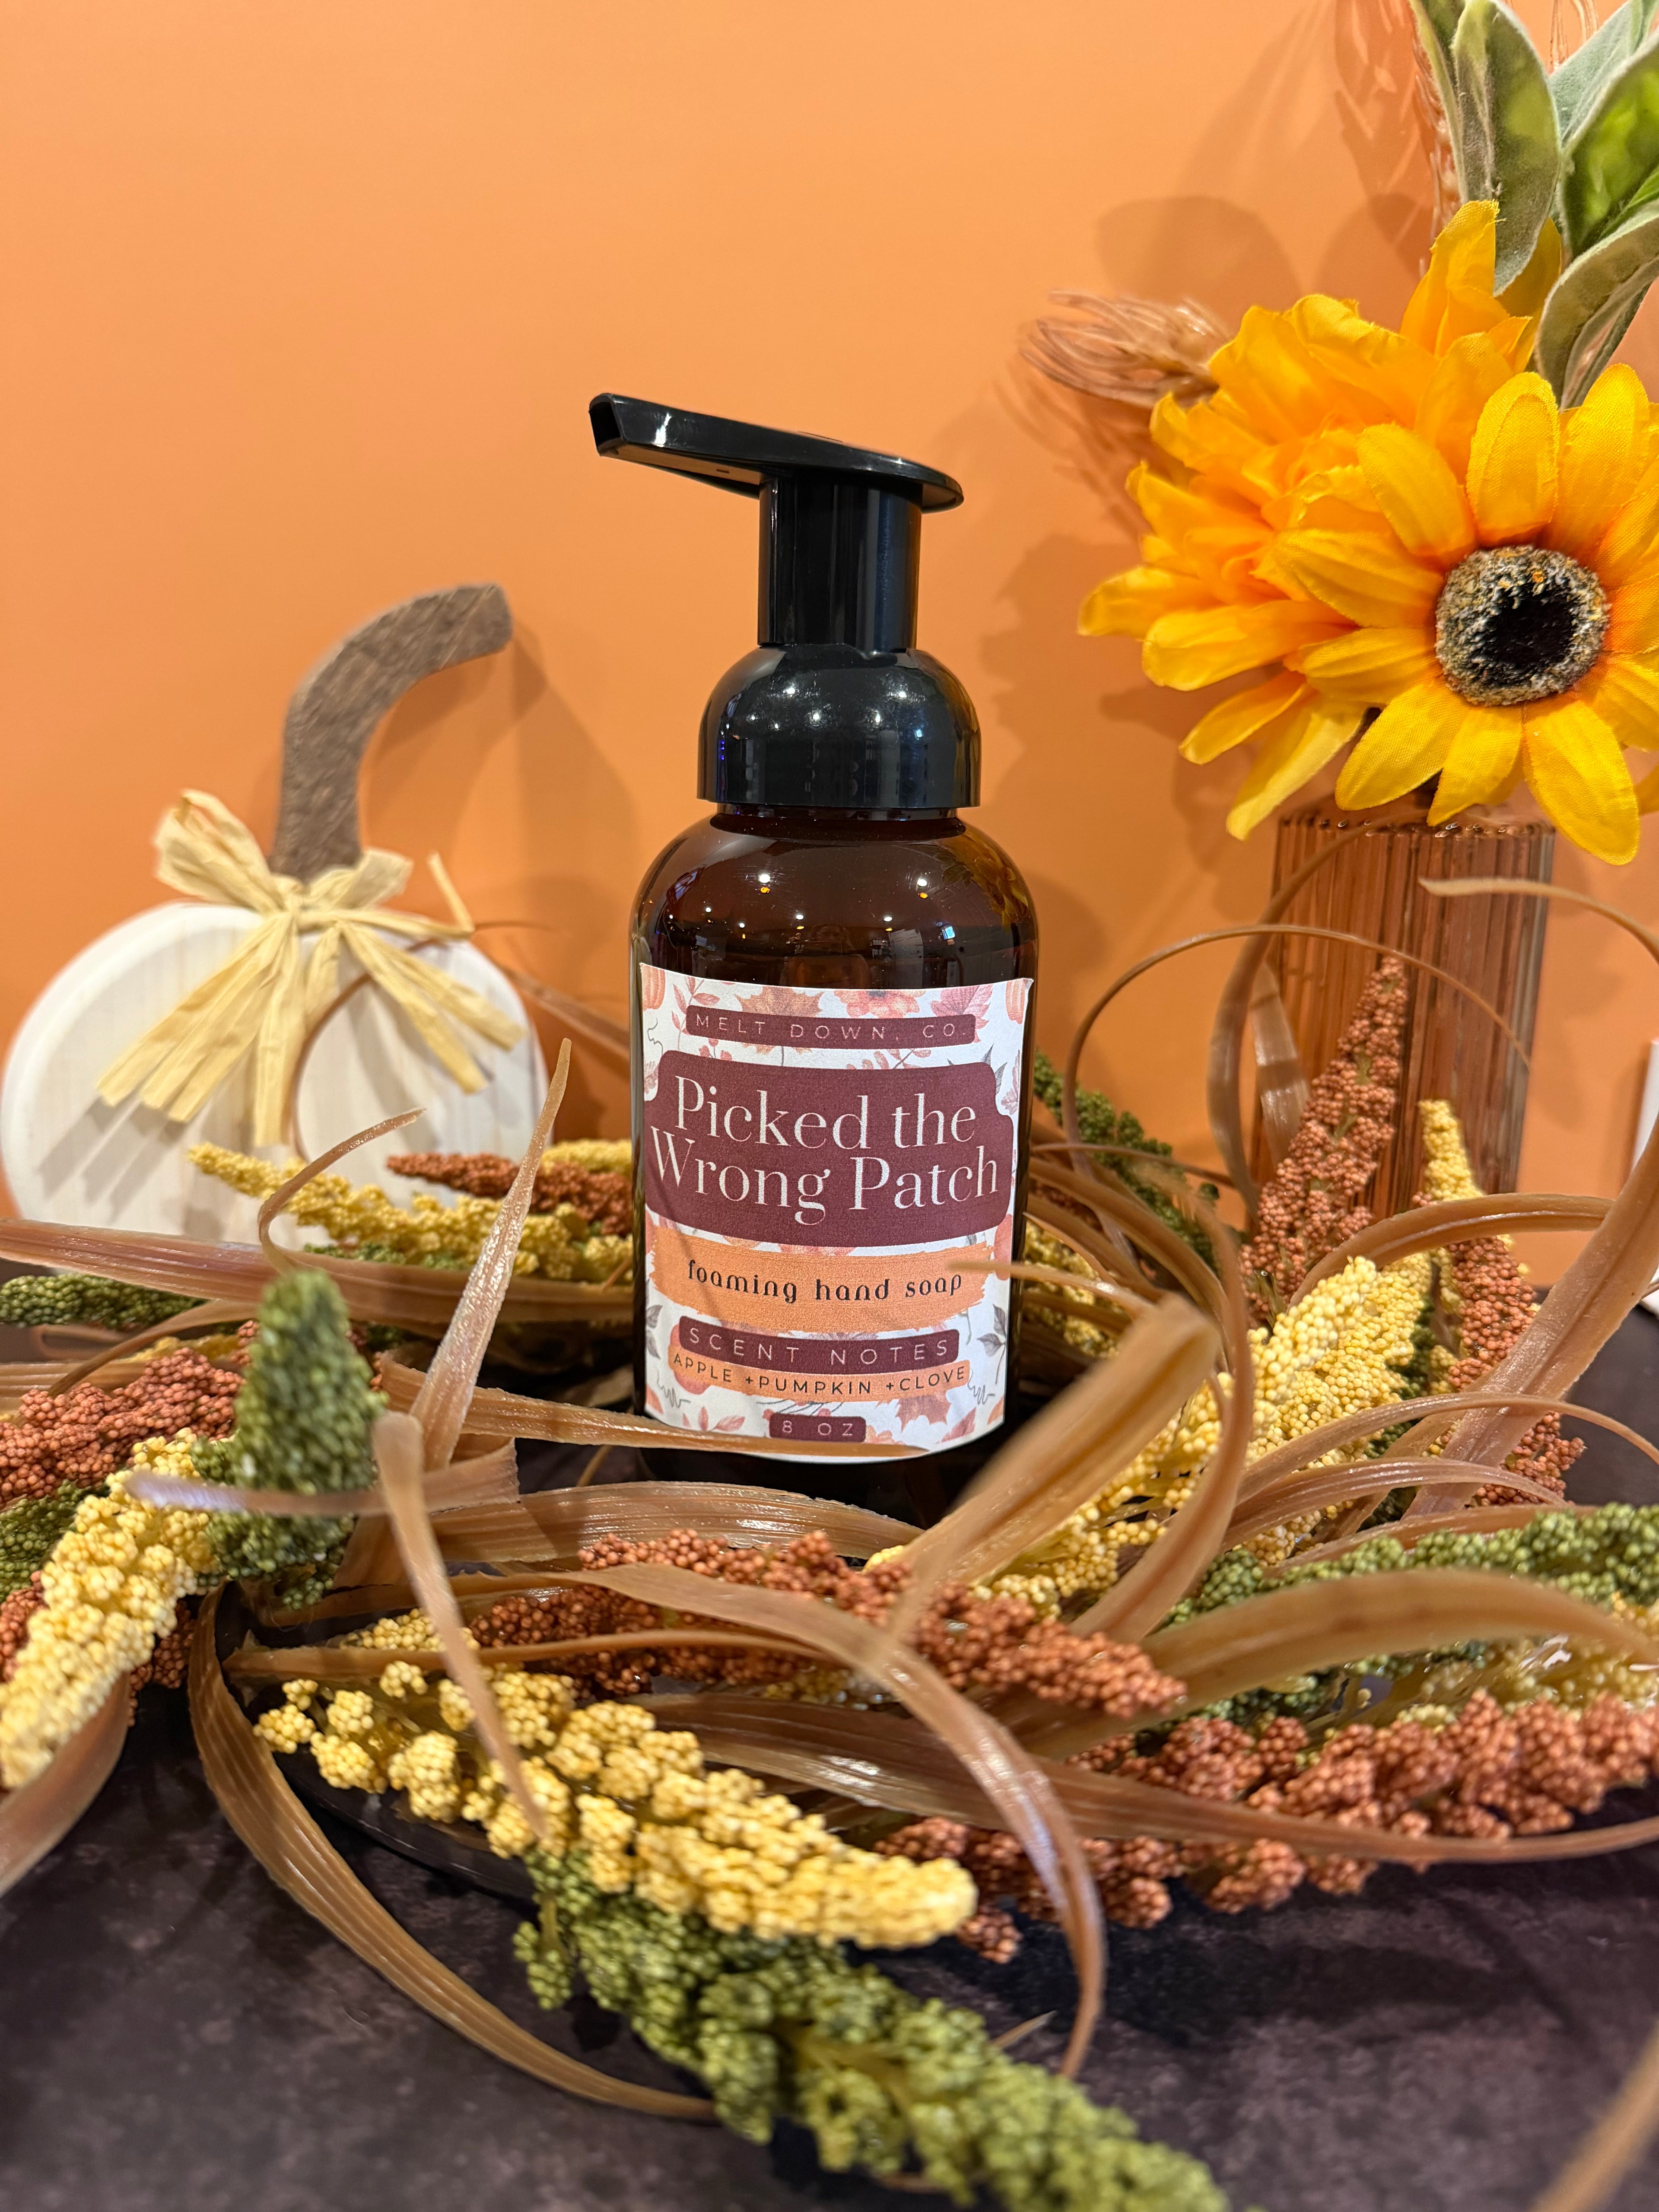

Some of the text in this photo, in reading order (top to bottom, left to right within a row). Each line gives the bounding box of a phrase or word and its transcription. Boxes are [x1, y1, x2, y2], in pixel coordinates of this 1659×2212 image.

[696, 1014, 765, 1034] MELT
[674, 1075, 976, 1150] Picked the
[650, 1126, 998, 1226] Wrong Patch
[688, 1259, 962, 1304] foaming hand soap
[690, 1328, 947, 1365] SCENT NOTES
[674, 1353, 731, 1382] APPLE
[782, 1420, 853, 1436] 8 OZ
